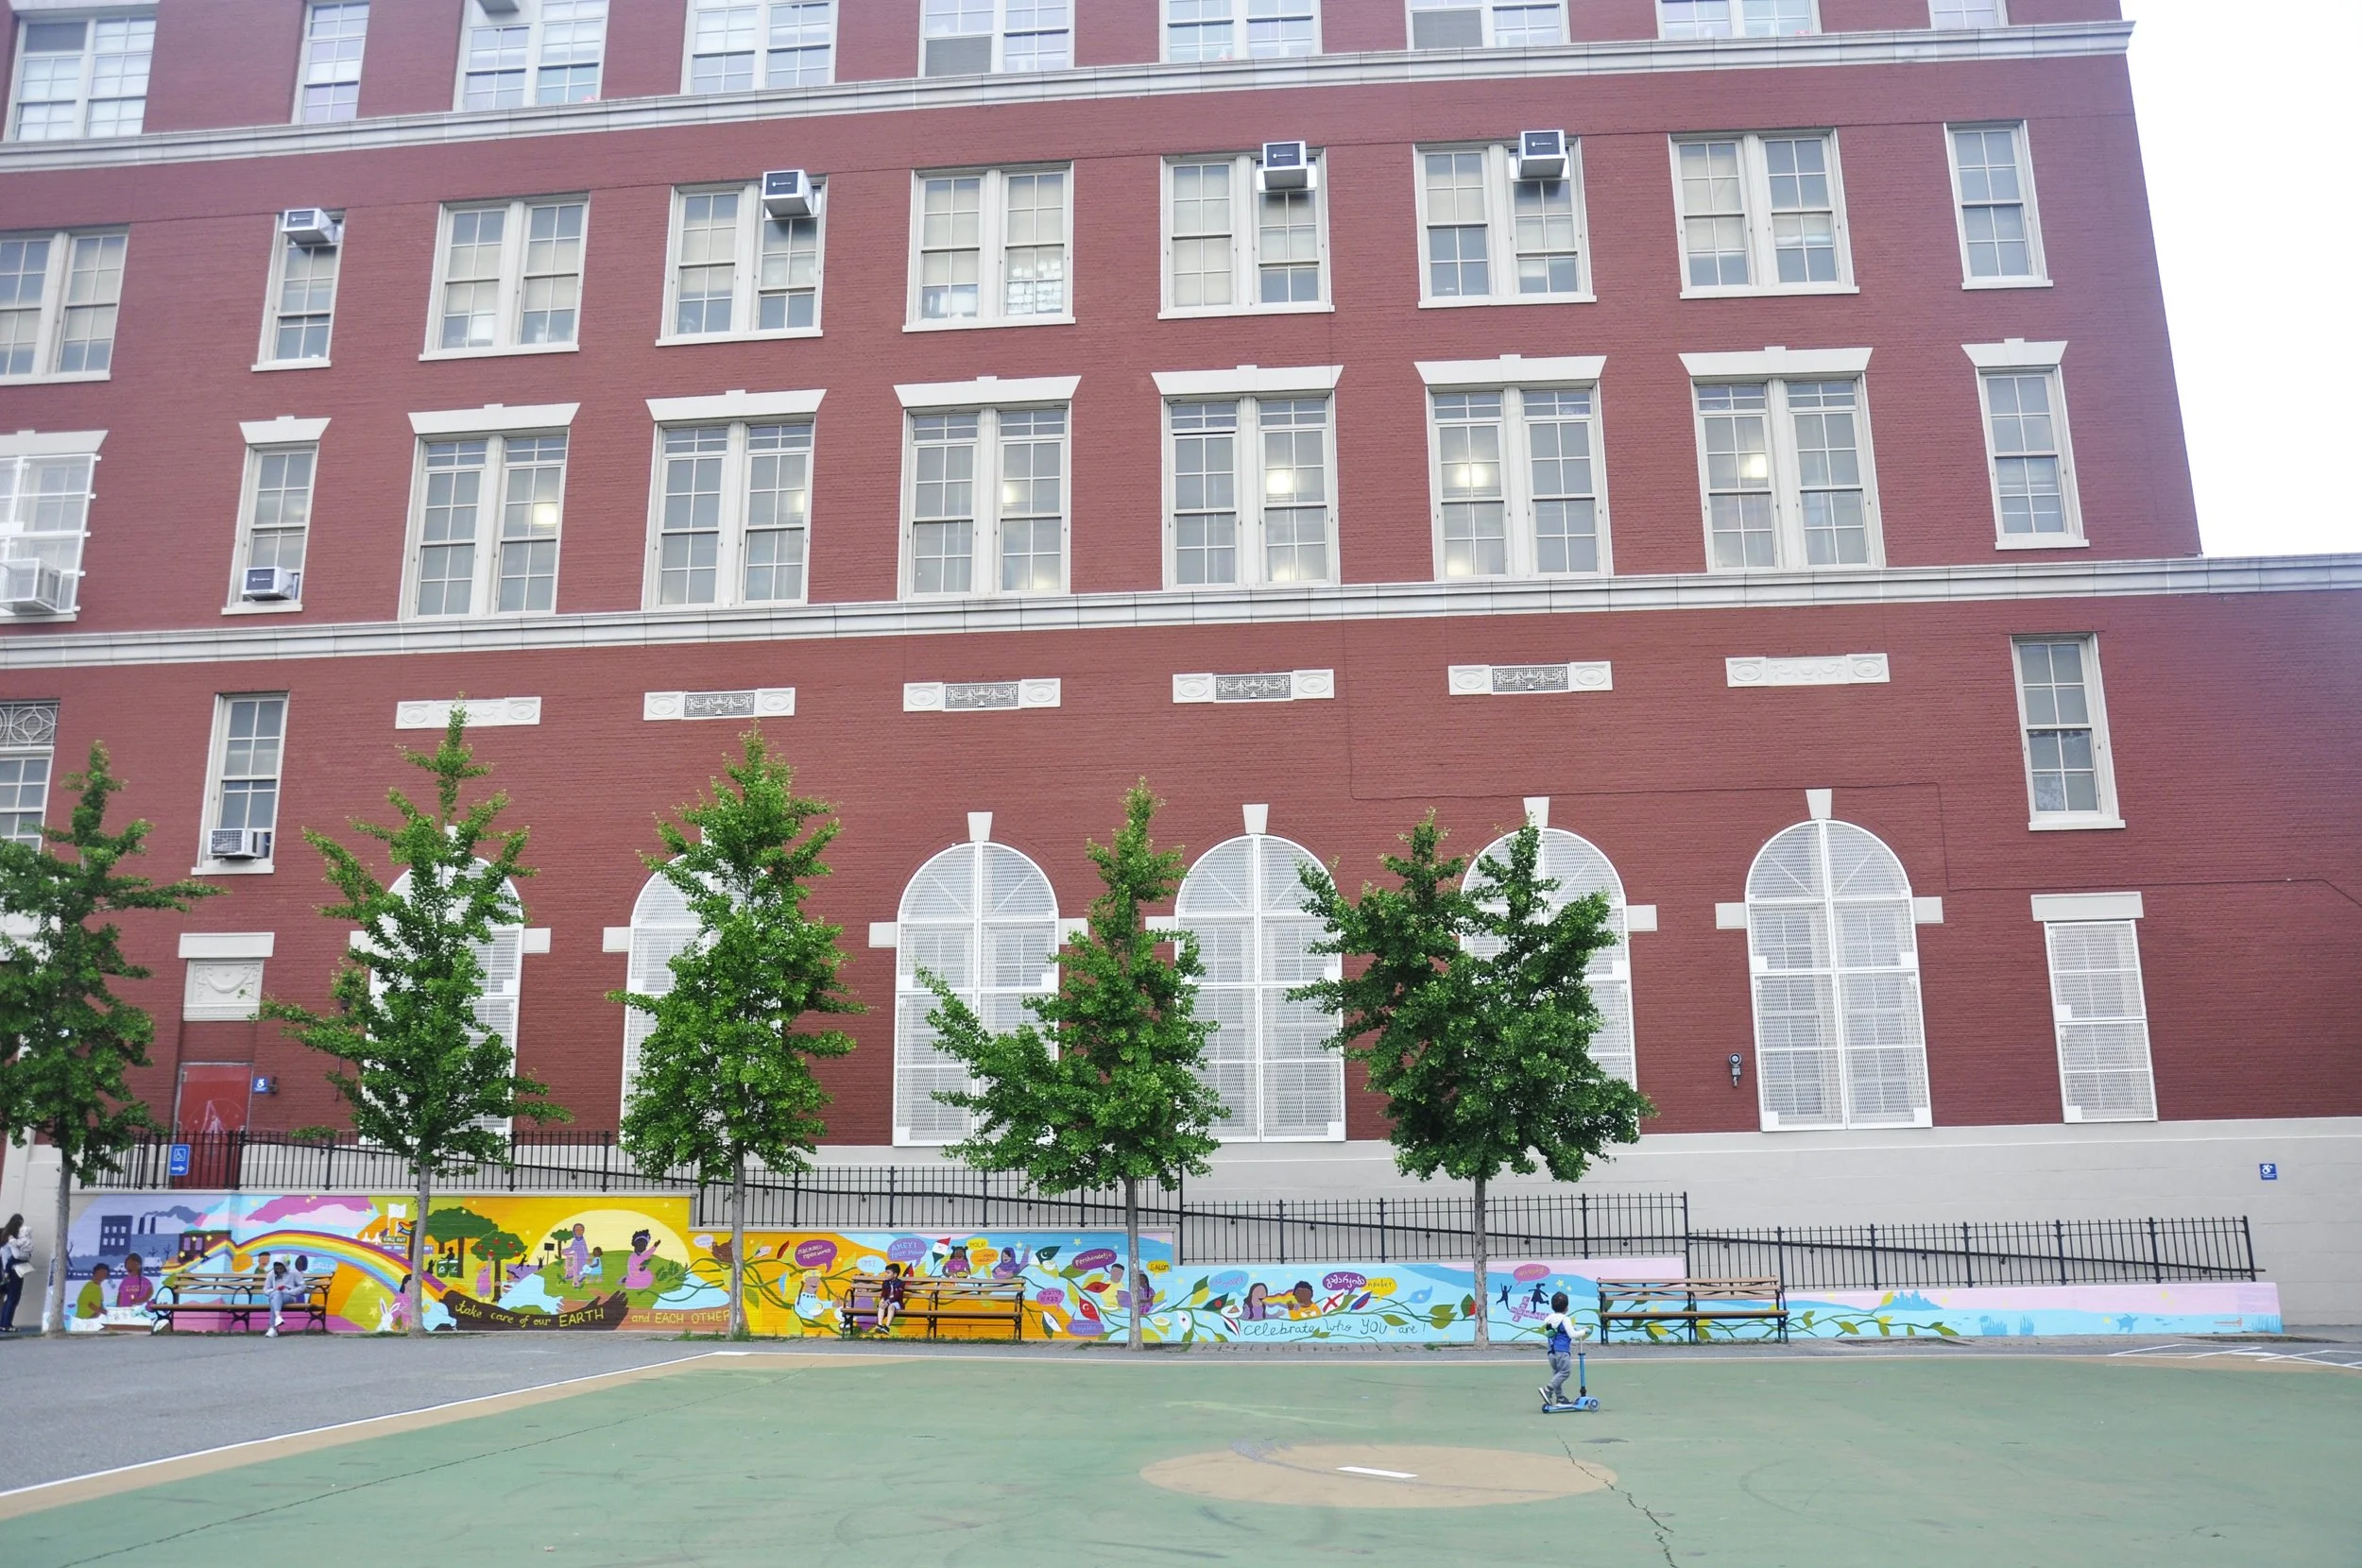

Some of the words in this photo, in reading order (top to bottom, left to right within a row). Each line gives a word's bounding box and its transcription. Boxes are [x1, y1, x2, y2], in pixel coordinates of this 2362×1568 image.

[454, 1300, 483, 1319] take
[490, 1313, 514, 1323] care
[519, 1315, 530, 1328] of
[533, 1318, 552, 1326] our
[558, 1307, 604, 1327] EARTH
[631, 1312, 650, 1322] and
[655, 1312, 684, 1323] EACH
[1243, 1321, 1315, 1337] celebrate
[1360, 1318, 1388, 1335] YOU
